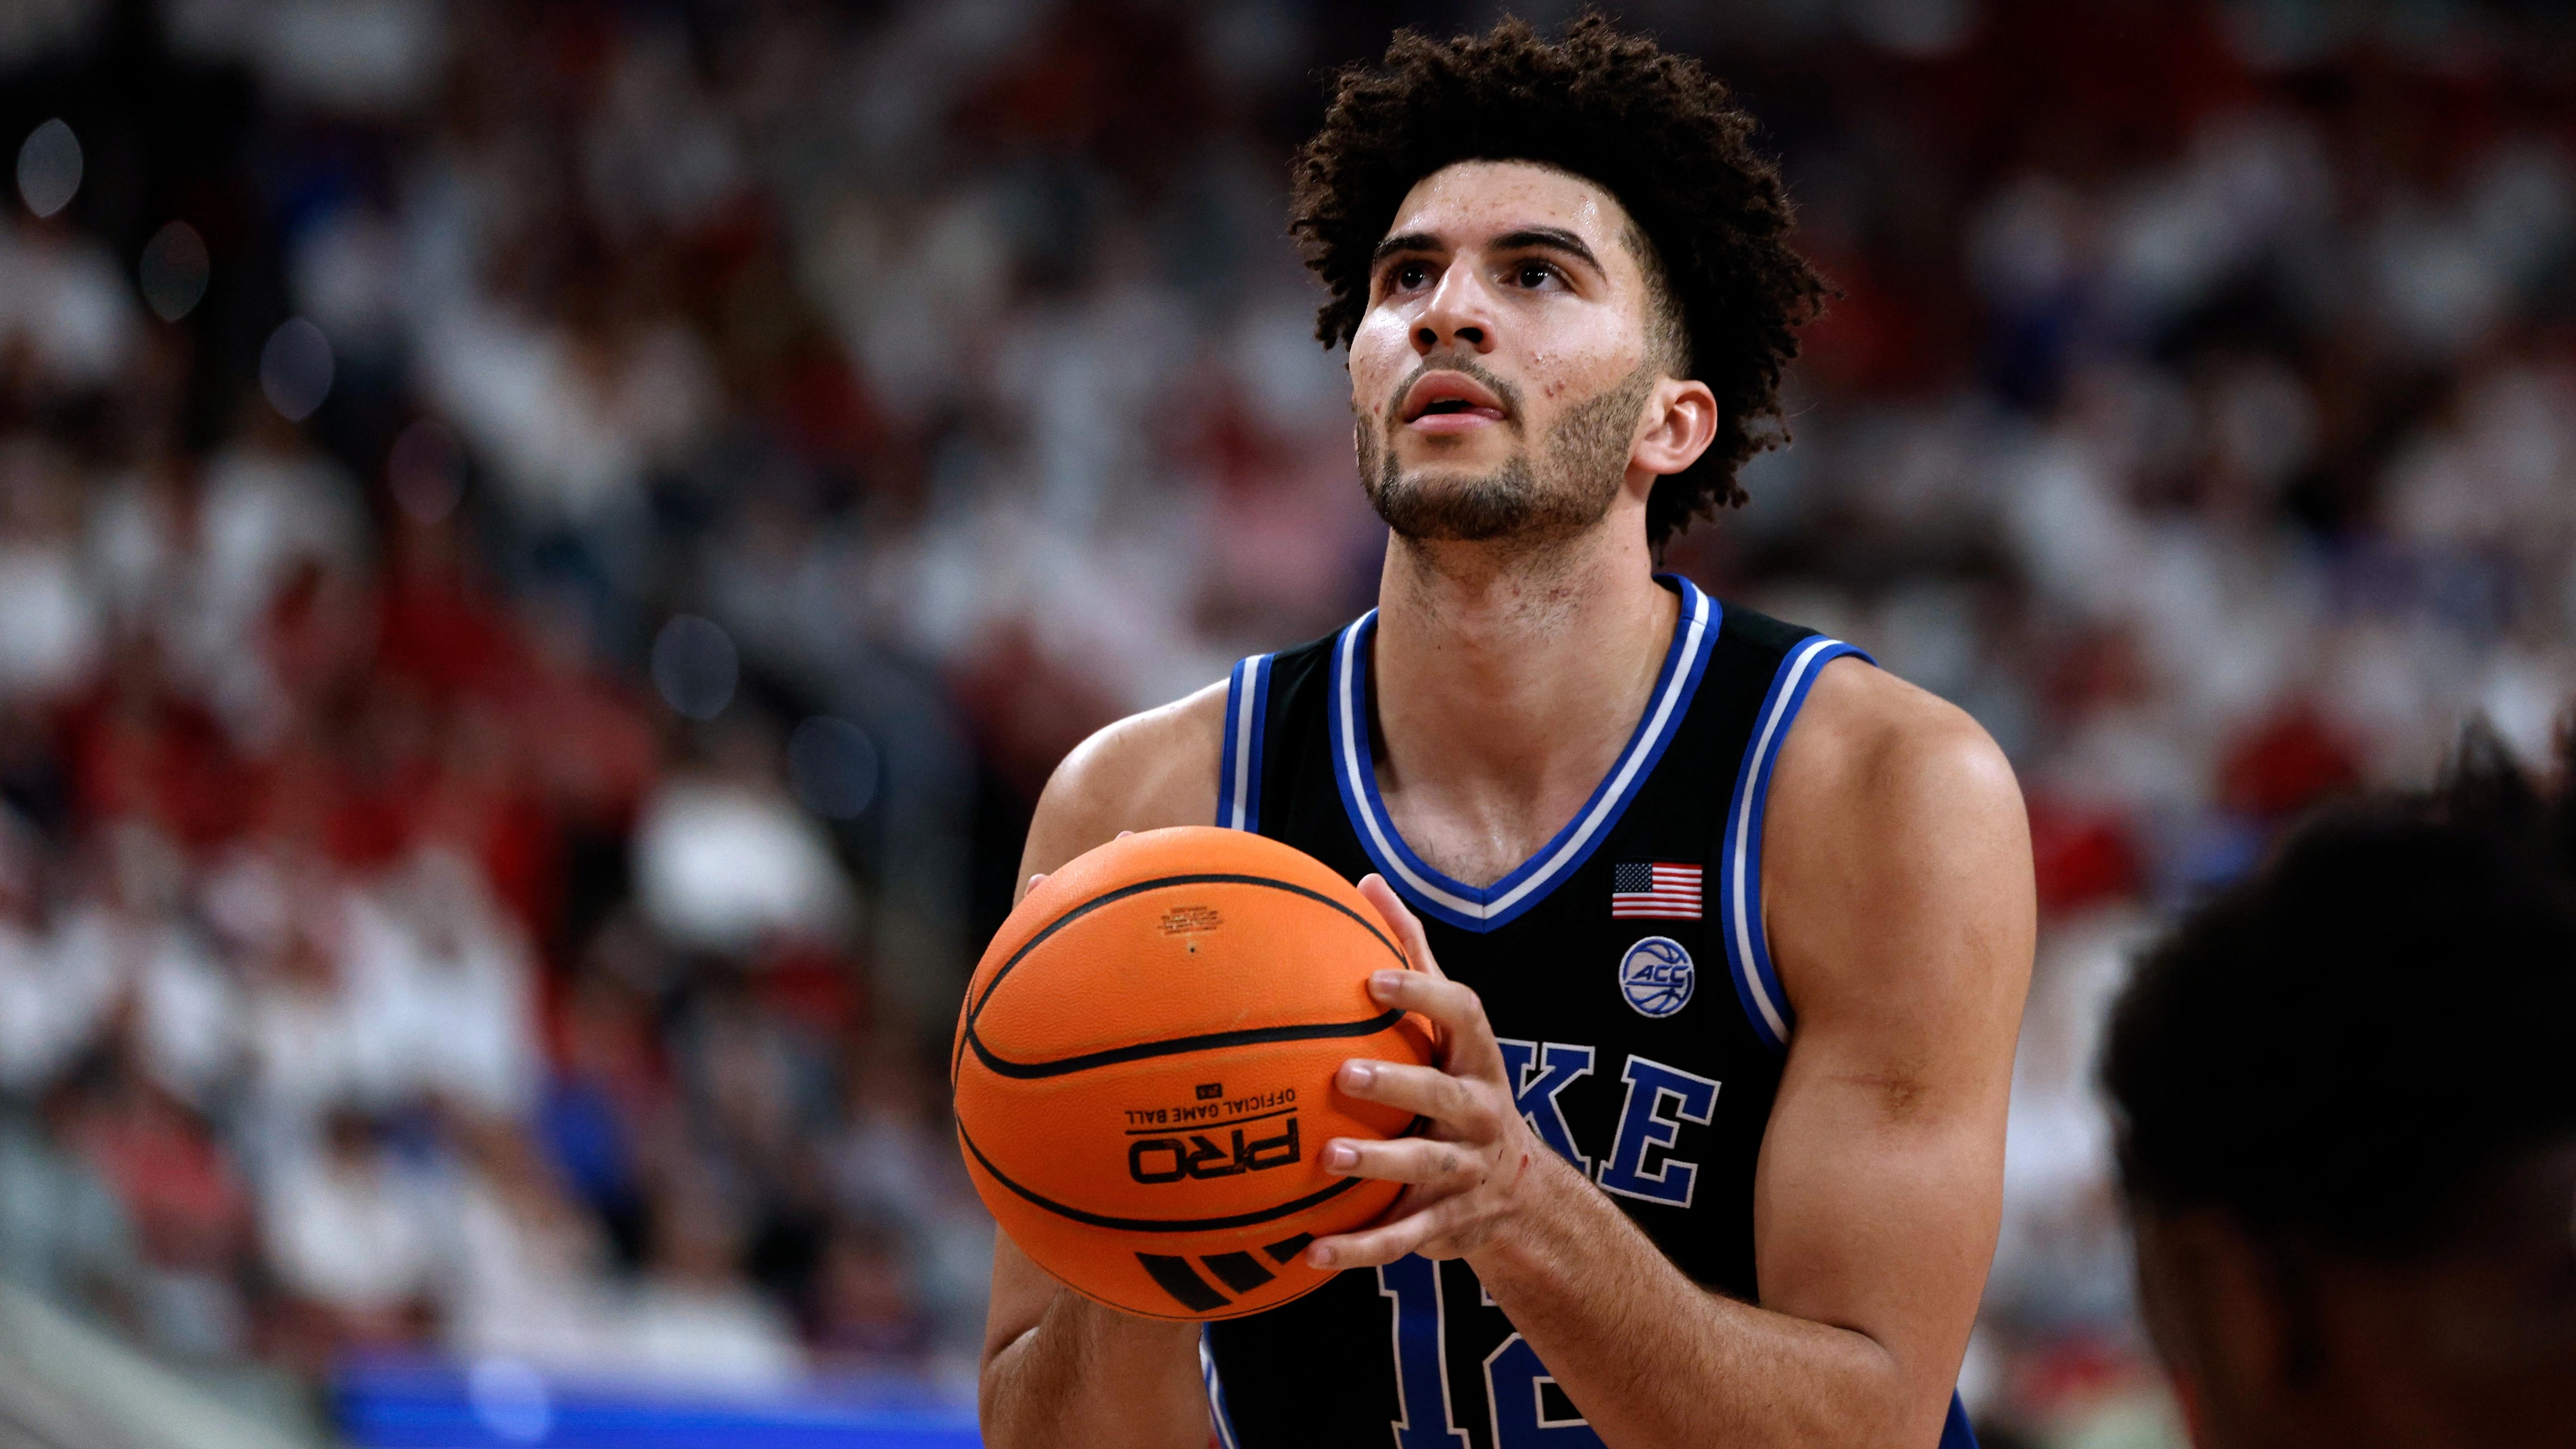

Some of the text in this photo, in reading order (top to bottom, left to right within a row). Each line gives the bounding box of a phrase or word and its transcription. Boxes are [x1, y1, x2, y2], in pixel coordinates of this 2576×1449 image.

[1631, 964, 1689, 983] ACC
[1173, 1103, 1219, 1123] GAME
[1223, 1088, 1296, 1115] OFFICIAL
[1125, 1109, 1167, 1124] BALL
[1494, 1036, 1722, 1209] KE
[1128, 1118, 1300, 1184] PRO
